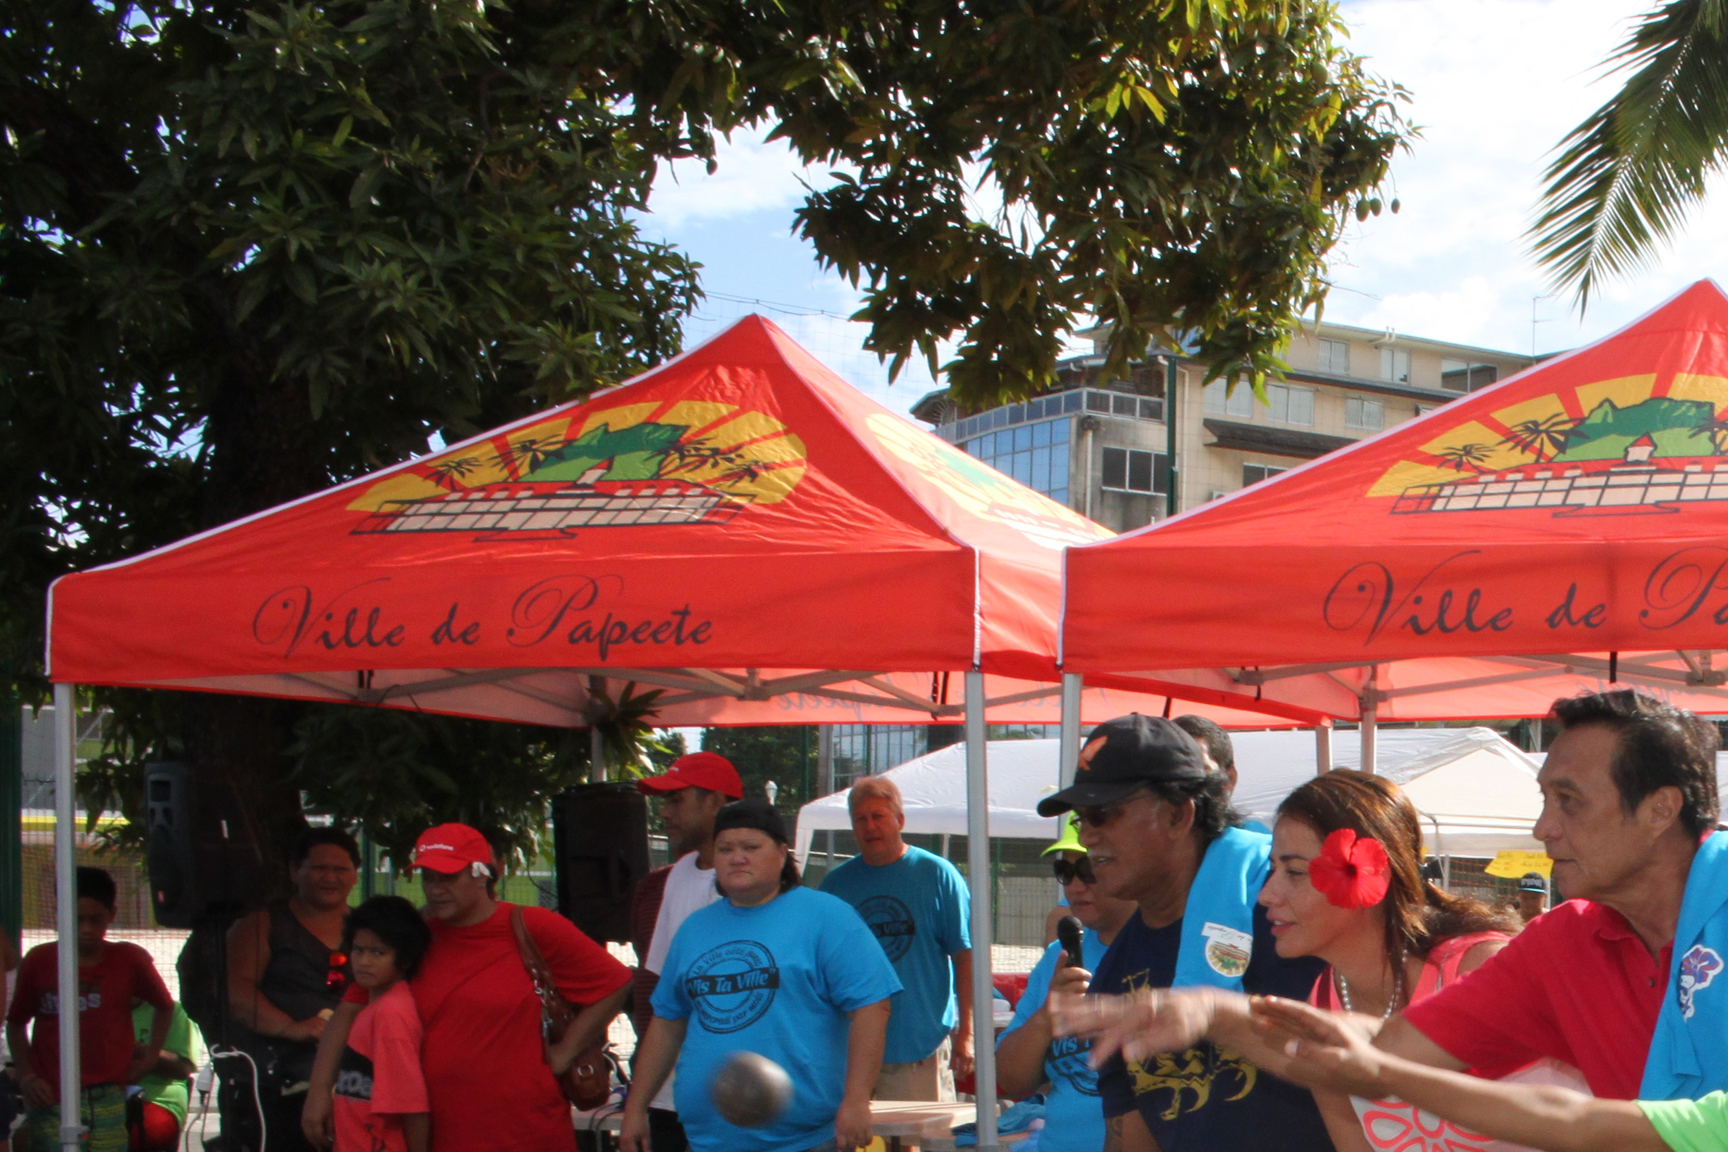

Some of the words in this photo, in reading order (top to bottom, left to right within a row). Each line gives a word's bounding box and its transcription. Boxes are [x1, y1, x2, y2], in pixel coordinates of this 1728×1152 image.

[253, 576, 405, 659] Ville
[430, 602, 480, 646] de
[505, 574, 712, 662] Papeete
[1323, 549, 1513, 647] Ville
[1545, 583, 1607, 629] de
[688, 978, 710, 995] Vis
[714, 977, 734, 993] Ta
[736, 969, 770, 990] Ville
